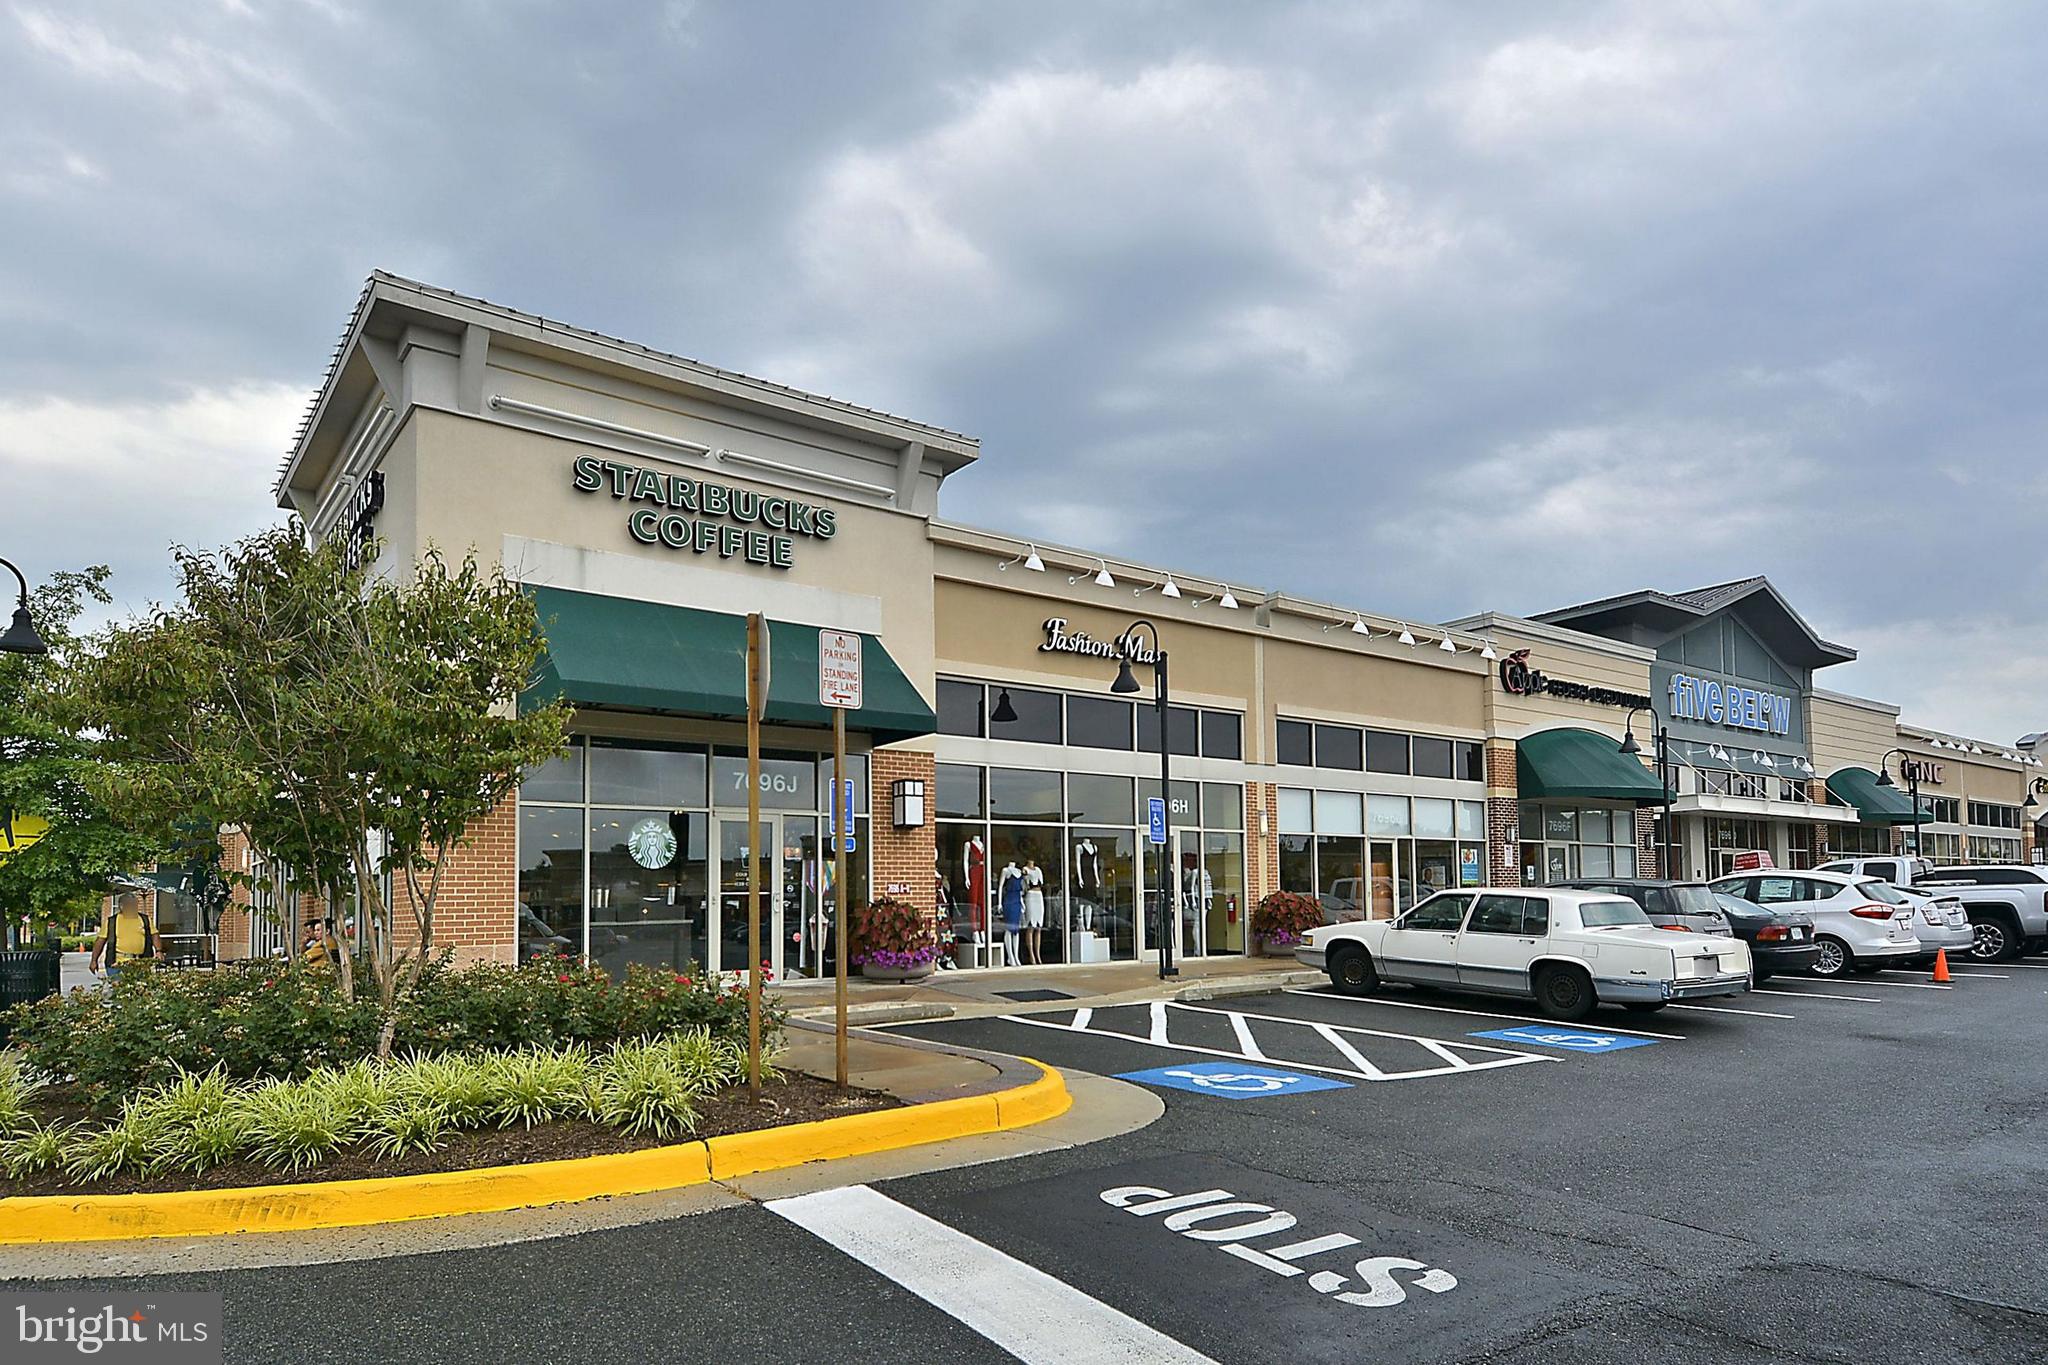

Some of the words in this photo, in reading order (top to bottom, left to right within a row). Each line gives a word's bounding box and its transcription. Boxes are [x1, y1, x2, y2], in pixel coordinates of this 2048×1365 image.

[573, 455, 838, 539] STARBUCKS
[628, 509, 794, 568] COFFEE
[835, 639, 846, 649] NO
[1042, 617, 1115, 659] Fashion
[824, 649, 857, 662] PARKING
[823, 679, 838, 690] FIRE
[841, 682, 857, 692] LANE
[824, 668, 857, 681] STANDING
[1669, 673, 1724, 724] five
[1725, 685, 1791, 735] BELOW
[733, 772, 798, 793] 796J
[1100, 1186, 1459, 1307] STOP
